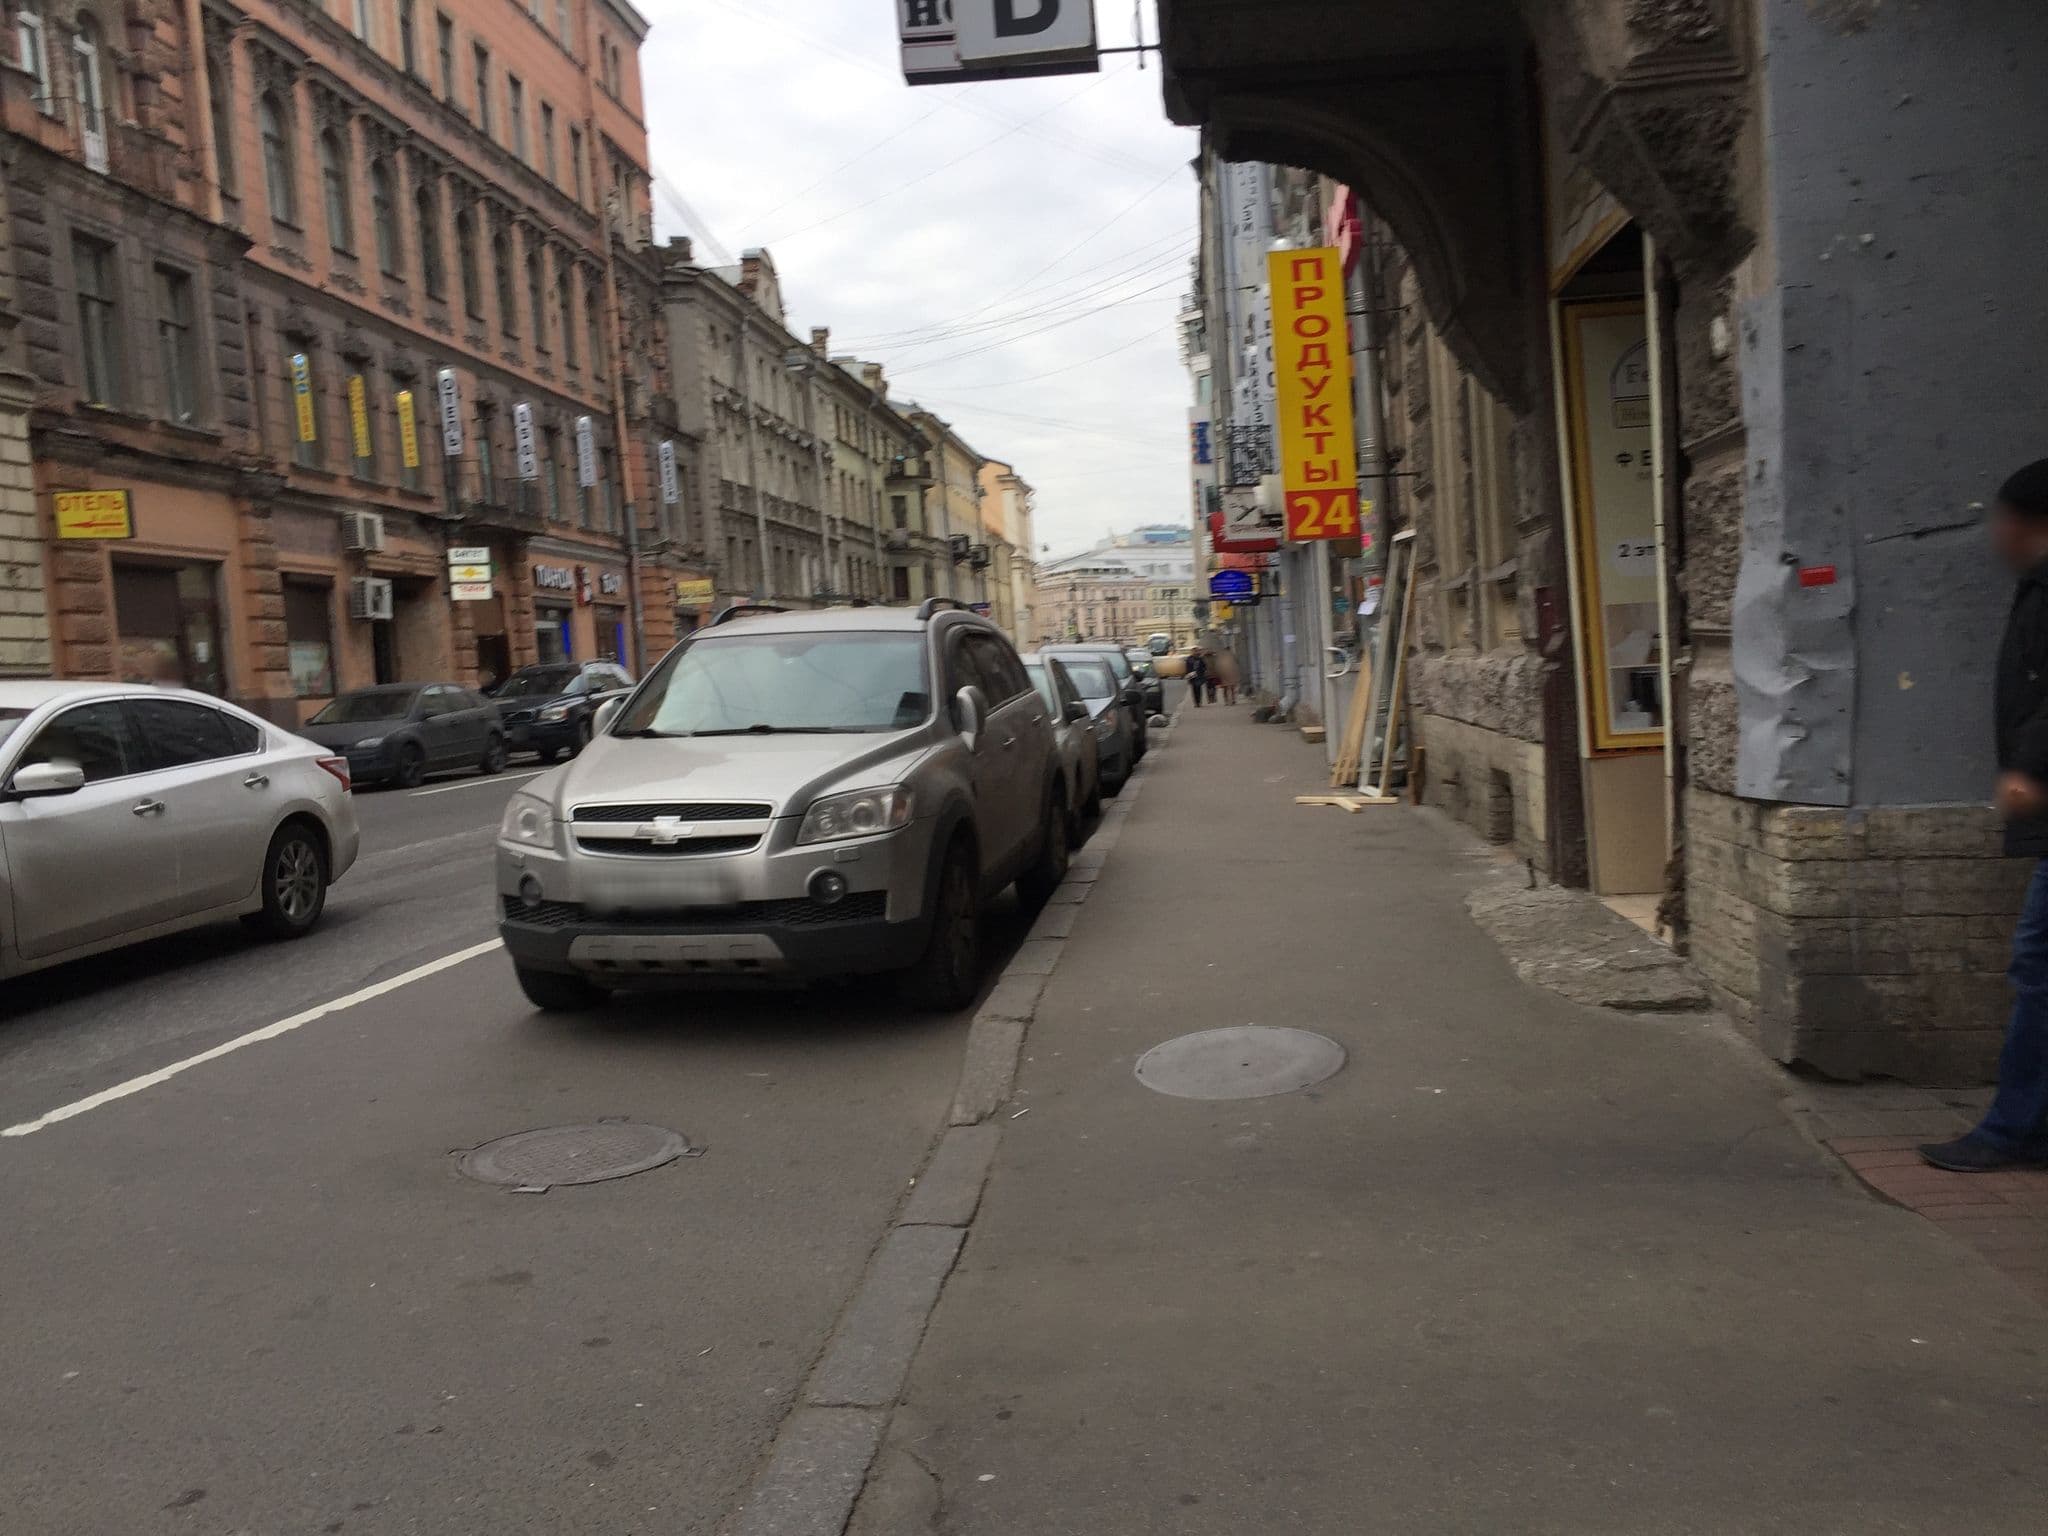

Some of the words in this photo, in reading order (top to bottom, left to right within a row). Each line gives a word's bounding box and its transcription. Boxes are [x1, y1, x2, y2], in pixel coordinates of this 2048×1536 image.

[1291, 257, 1339, 483] ПРОДУКТЫ
[56, 495, 124, 512] ОТЕЛЬ
[1293, 494, 1355, 536] 24
